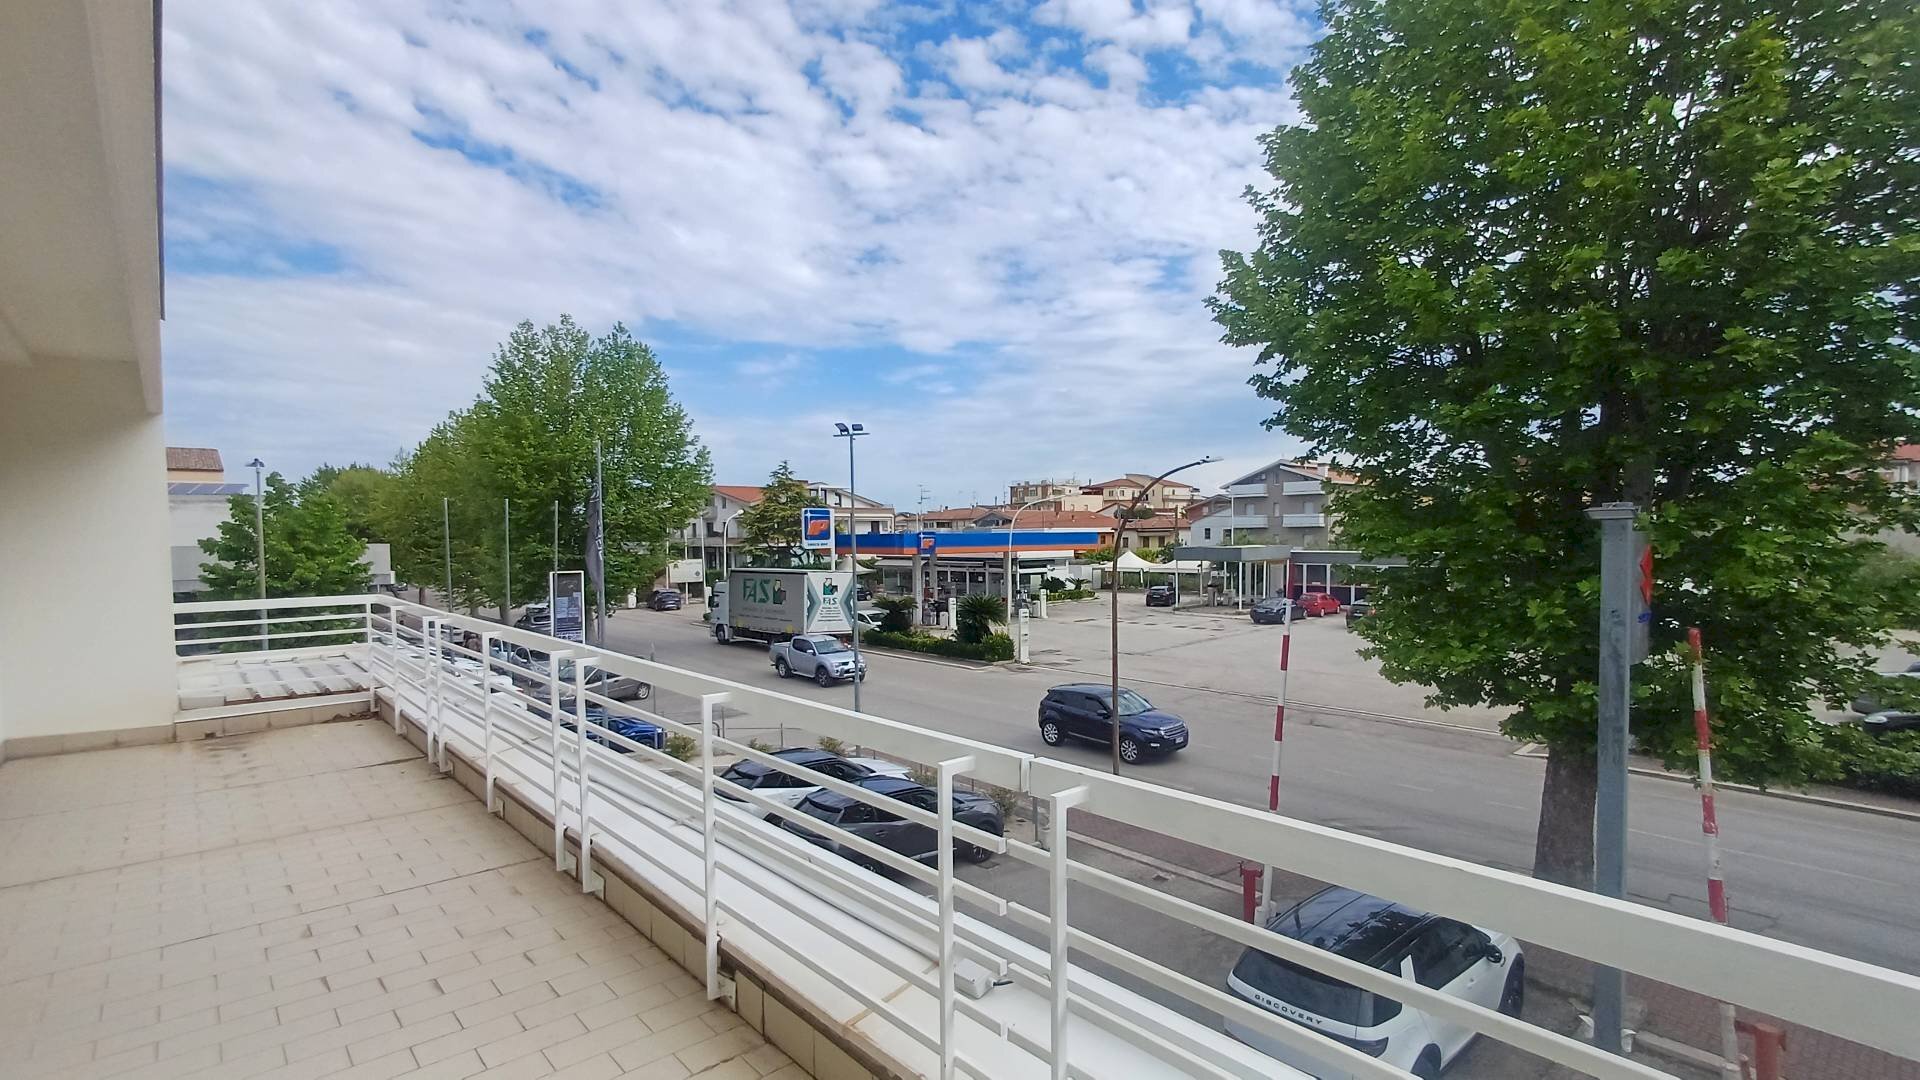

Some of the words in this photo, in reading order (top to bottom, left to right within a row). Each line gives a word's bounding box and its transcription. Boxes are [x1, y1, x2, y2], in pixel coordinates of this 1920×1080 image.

[743, 578, 771, 604] FAS
[823, 597, 838, 606] FAS
[1254, 994, 1323, 1025] DISCOVERY
